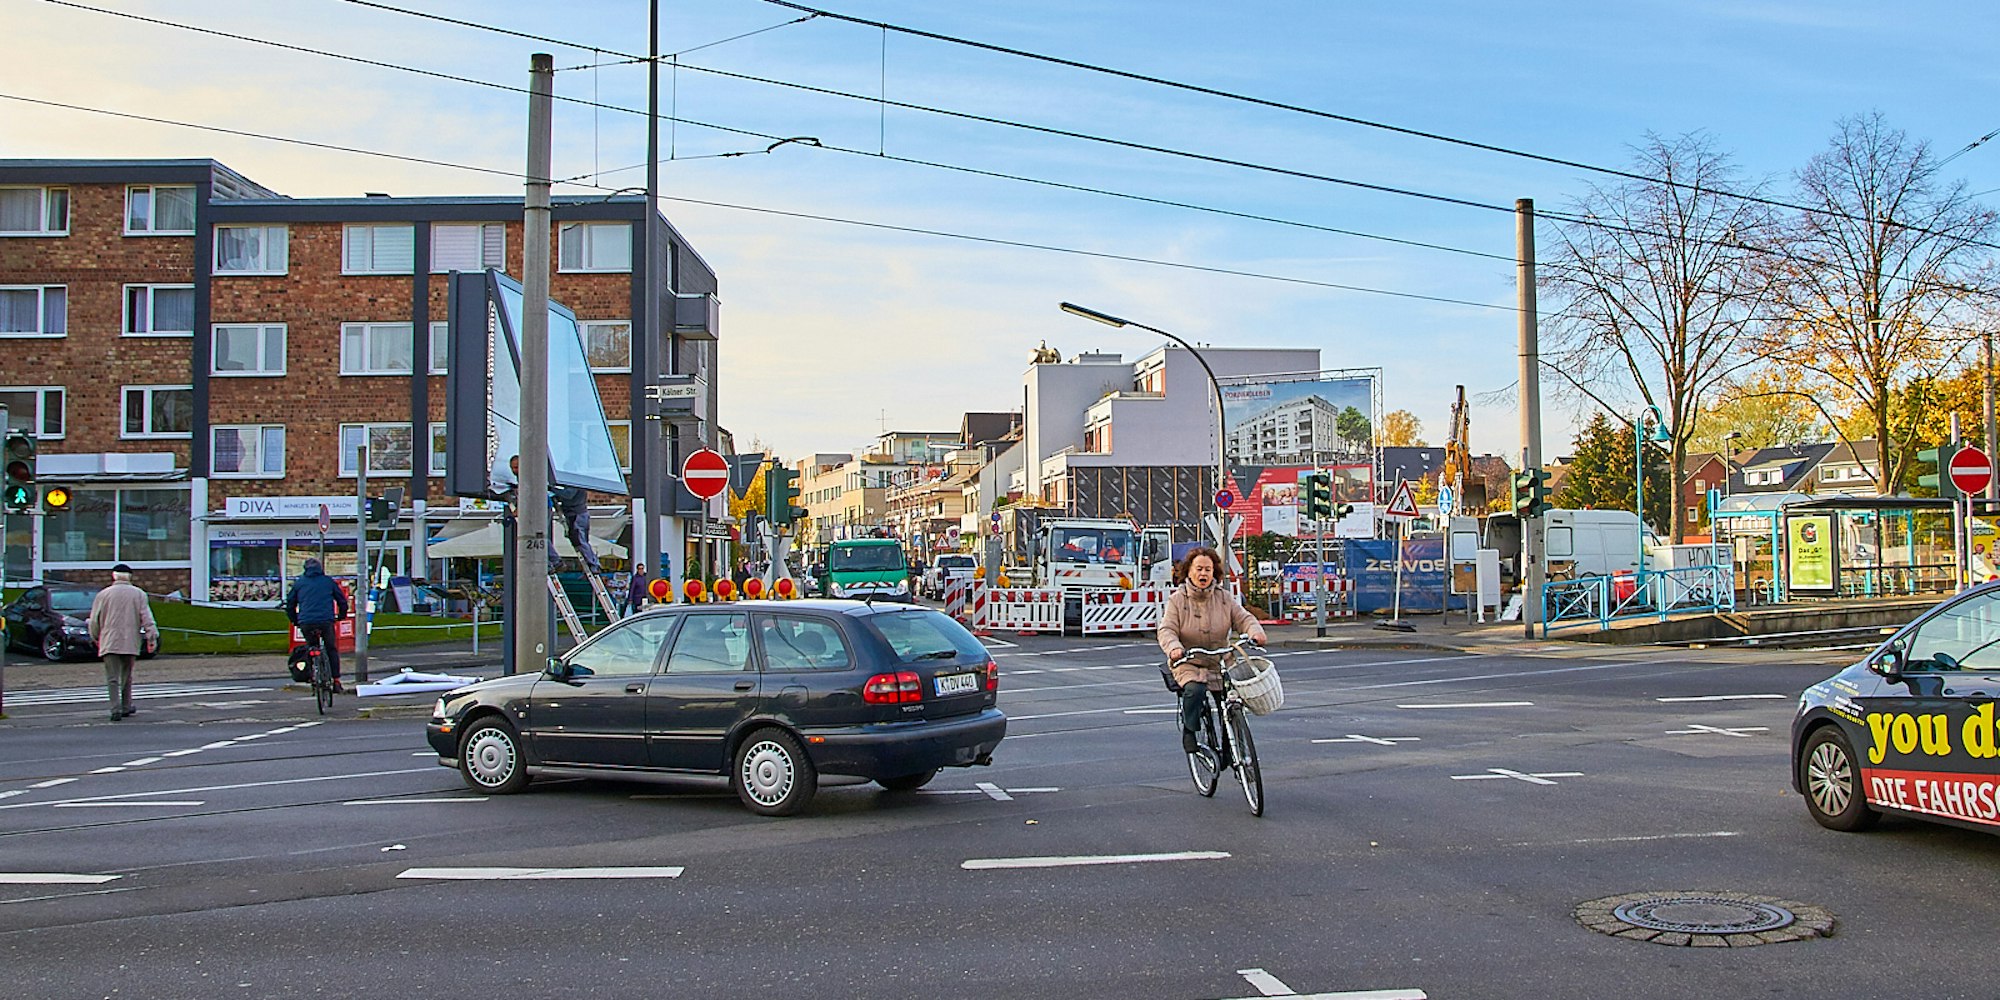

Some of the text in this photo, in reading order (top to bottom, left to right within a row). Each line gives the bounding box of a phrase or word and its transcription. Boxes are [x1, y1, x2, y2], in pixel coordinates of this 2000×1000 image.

[662, 387, 697, 396] Kölner Str.
[239, 501, 275, 513] DIVA
[1365, 558, 1446, 573] ZERVOS
[939, 679, 947, 691] K
[1866, 713, 1952, 765] you
[1871, 777, 1911, 808] DIE
